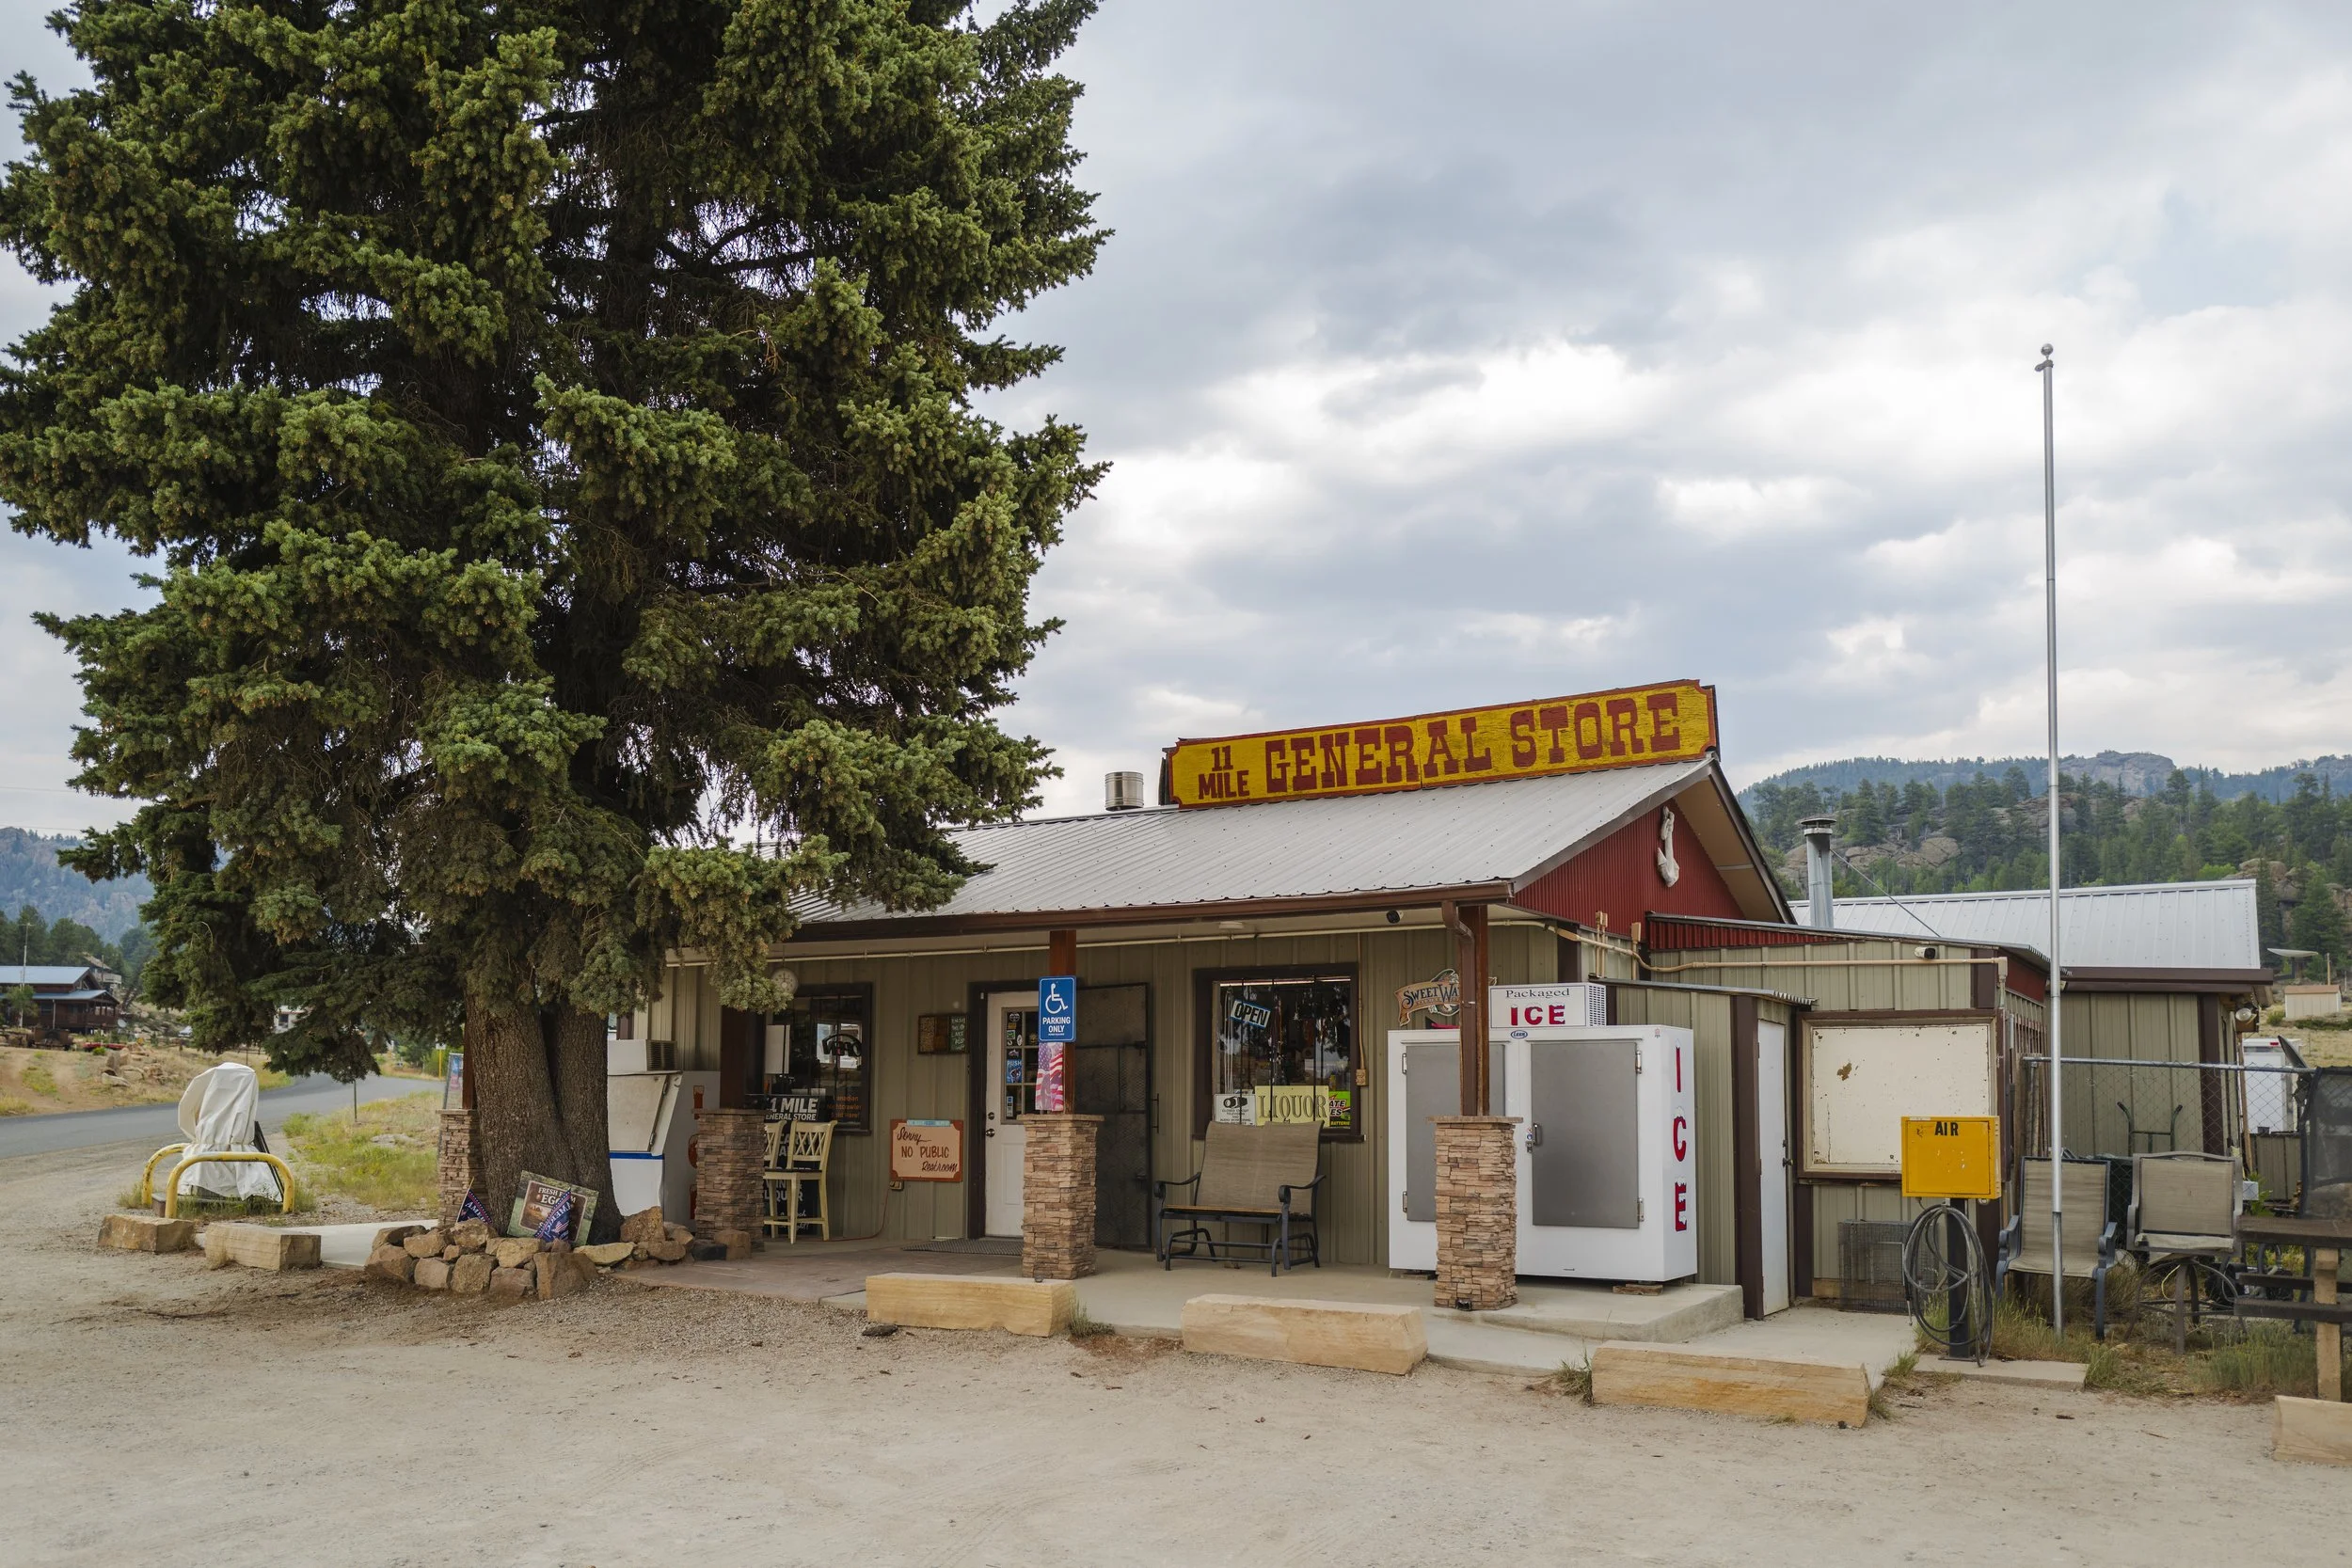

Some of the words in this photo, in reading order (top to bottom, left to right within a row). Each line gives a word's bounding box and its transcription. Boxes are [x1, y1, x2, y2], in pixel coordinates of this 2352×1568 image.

[1264, 716, 1493, 794] GENERAL
[1510, 692, 1681, 768] STORE
[1211, 745, 1233, 771] 11
[1198, 769, 1250, 800] MILE
[1505, 988, 1570, 999] Packaged
[1042, 1016, 1071, 1024] PARKING
[1233, 1003, 1268, 1027] OPEN
[1510, 1004, 1565, 1026] ICE
[780, 1098, 818, 1114] MILE
[1258, 1095, 1327, 1119] LIQUOR
[897, 1126, 930, 1146] Sorry
[1673, 1038, 1688, 1231] ICE
[1934, 1120, 1959, 1136] AIR
[900, 1146, 914, 1158] NO
[919, 1146, 949, 1158] PUBLIC
[538, 1187, 558, 1196] FRESH
[540, 1195, 561, 1205] EG
[764, 1190, 803, 1202] LQUR
